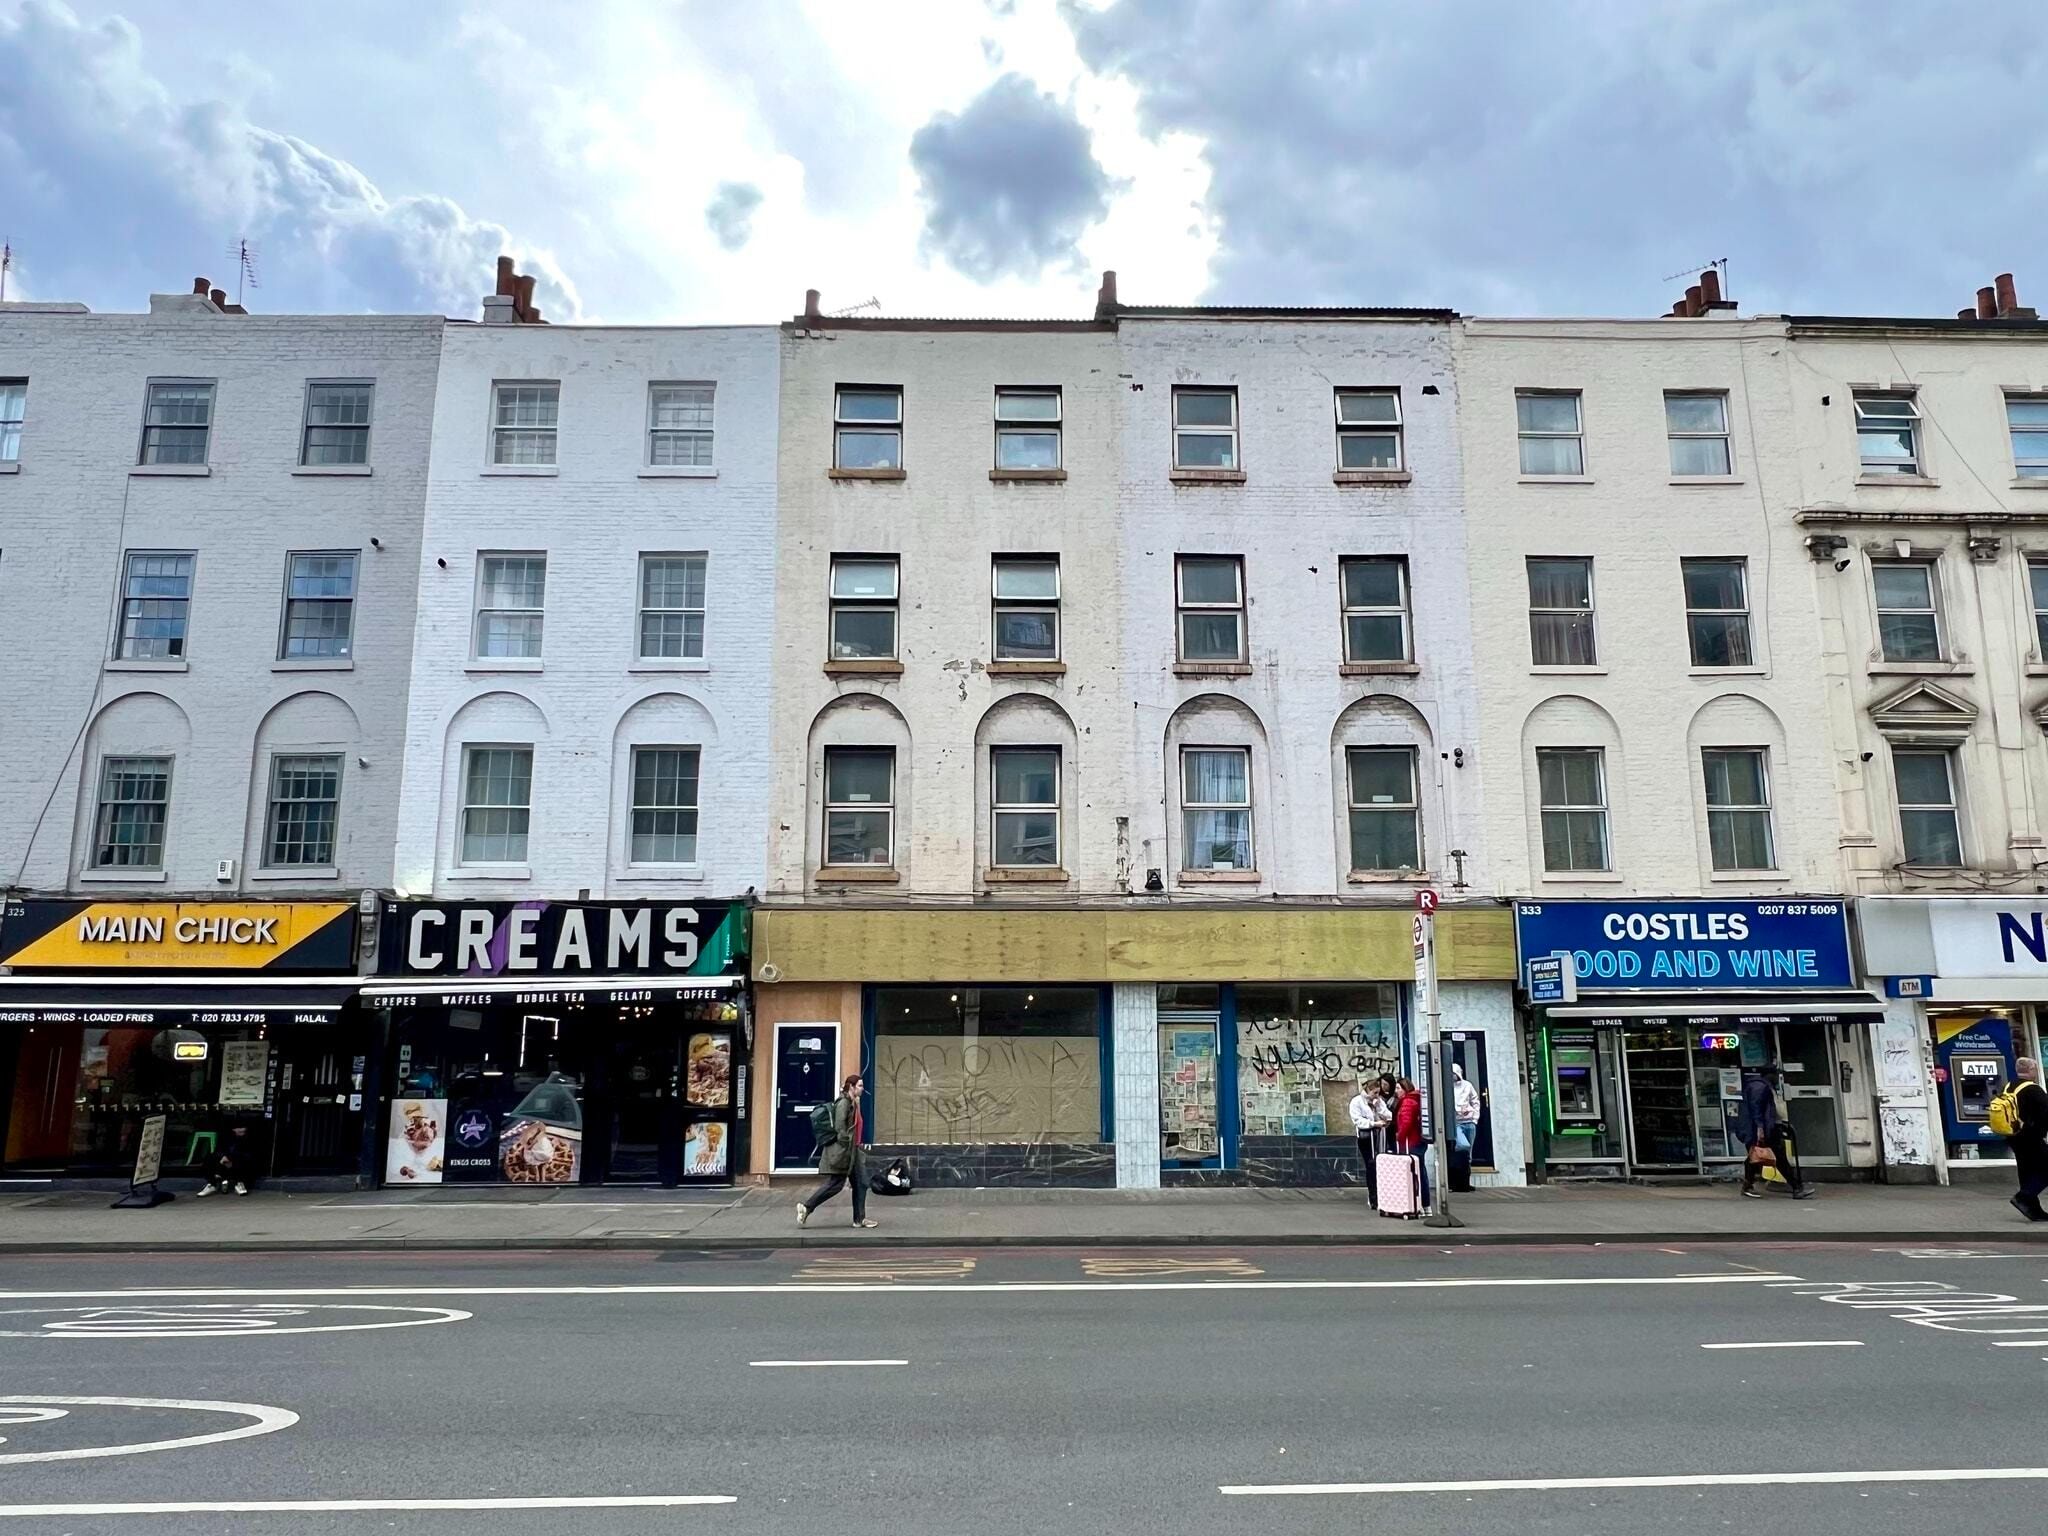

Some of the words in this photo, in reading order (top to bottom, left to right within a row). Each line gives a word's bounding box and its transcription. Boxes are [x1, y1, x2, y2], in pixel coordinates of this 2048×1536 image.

[1420, 893, 1433, 908] R
[7, 908, 25, 917] 325
[1520, 906, 1542, 915] 333
[1757, 905, 1785, 915] 0207
[1787, 905, 1807, 915] 837
[1810, 905, 1838, 915] 5009
[79, 916, 165, 943] MAIN
[175, 917, 279, 944] CHICK
[1603, 913, 1749, 941] COSTLES
[408, 908, 699, 970] CREAMS
[1651, 950, 1721, 978] AND
[1728, 950, 1819, 978] WINE
[1901, 981, 1920, 992] ATM
[374, 997, 417, 1006] CREPES
[442, 995, 491, 1005] WAFFLES
[516, 993, 558, 1003] BUBBLE
[565, 993, 585, 1002] TEA
[610, 991, 652, 1001] GELATO
[676, 990, 717, 999] COFFEE
[0, 1013, 36, 1022] RGERS
[43, 1013, 76, 1022] WINGS
[83, 1013, 123, 1022] LOADED
[125, 1014, 154, 1022] FRIES
[201, 1014, 219, 1023] 020
[221, 1014, 242, 1023] 7833
[295, 1014, 328, 1023] HALAL
[1958, 1033, 1973, 1041] Free
[1974, 1033, 1991, 1041] Cash
[1954, 1040, 1997, 1049] Withdrawals
[1967, 1064, 1994, 1074] ATM
